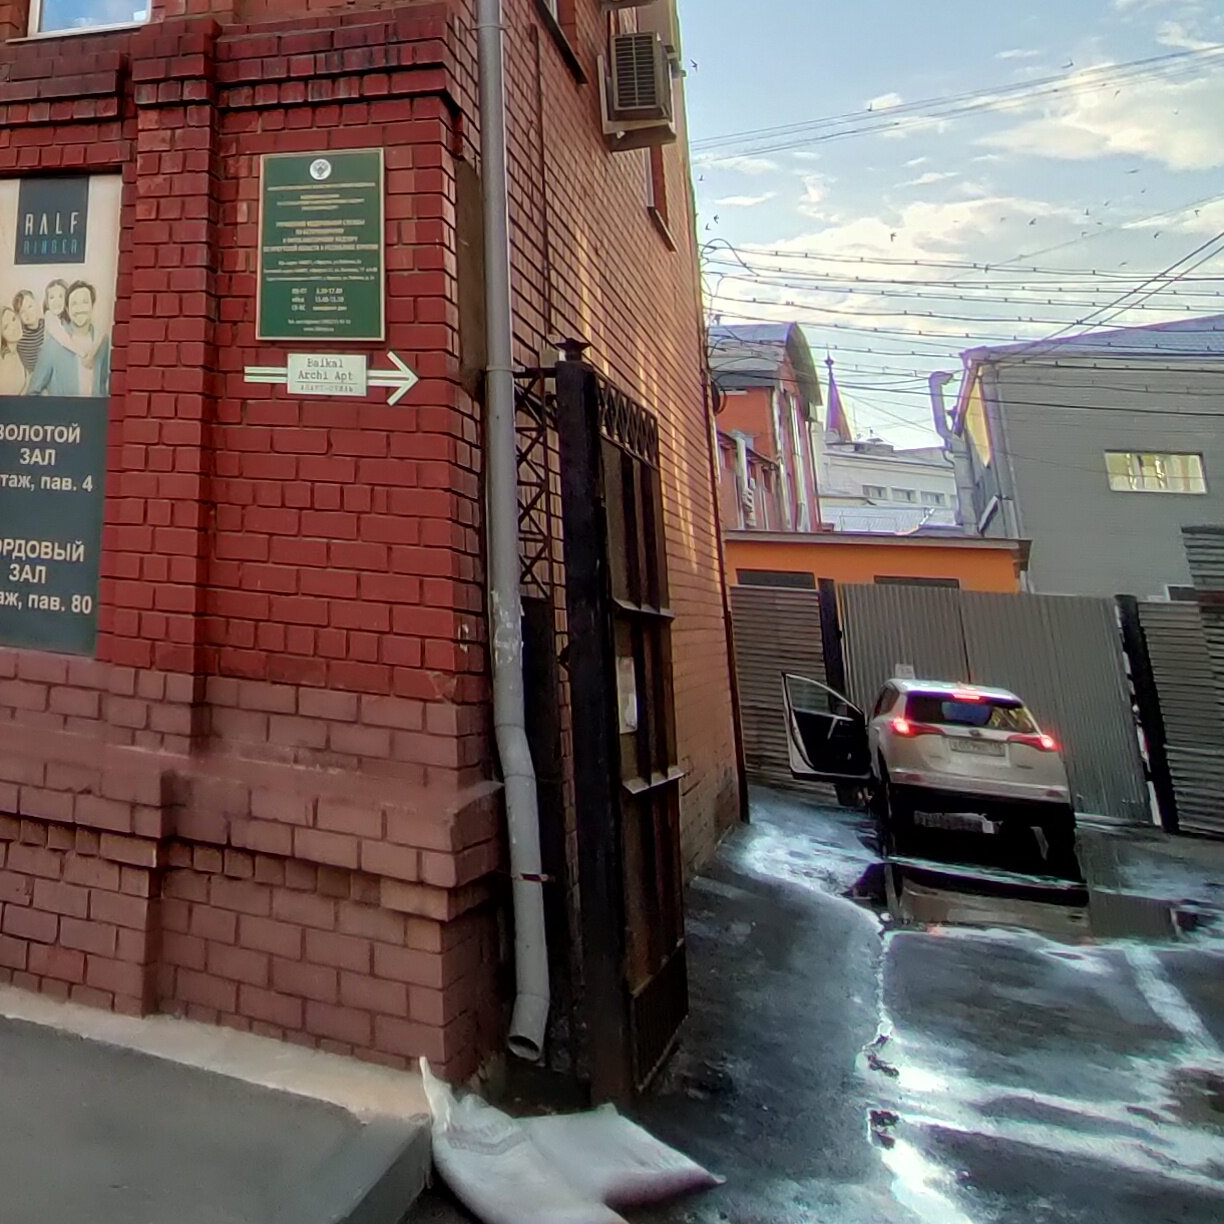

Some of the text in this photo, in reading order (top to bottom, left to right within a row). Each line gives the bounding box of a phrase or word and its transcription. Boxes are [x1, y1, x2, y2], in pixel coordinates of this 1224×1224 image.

[25, 212, 79, 236] RALF
[23, 239, 77, 254] RINGER
[307, 358, 343, 368] Baikal
[298, 370, 353, 382] Archi Apt
[19, 448, 56, 466] ЗАЛ
[40, 476, 77, 491] пав.
[82, 475, 93, 492] 4
[8, 564, 47, 584] ЗАЛ
[28, 593, 65, 611] пав.
[71, 595, 92, 614] 80
